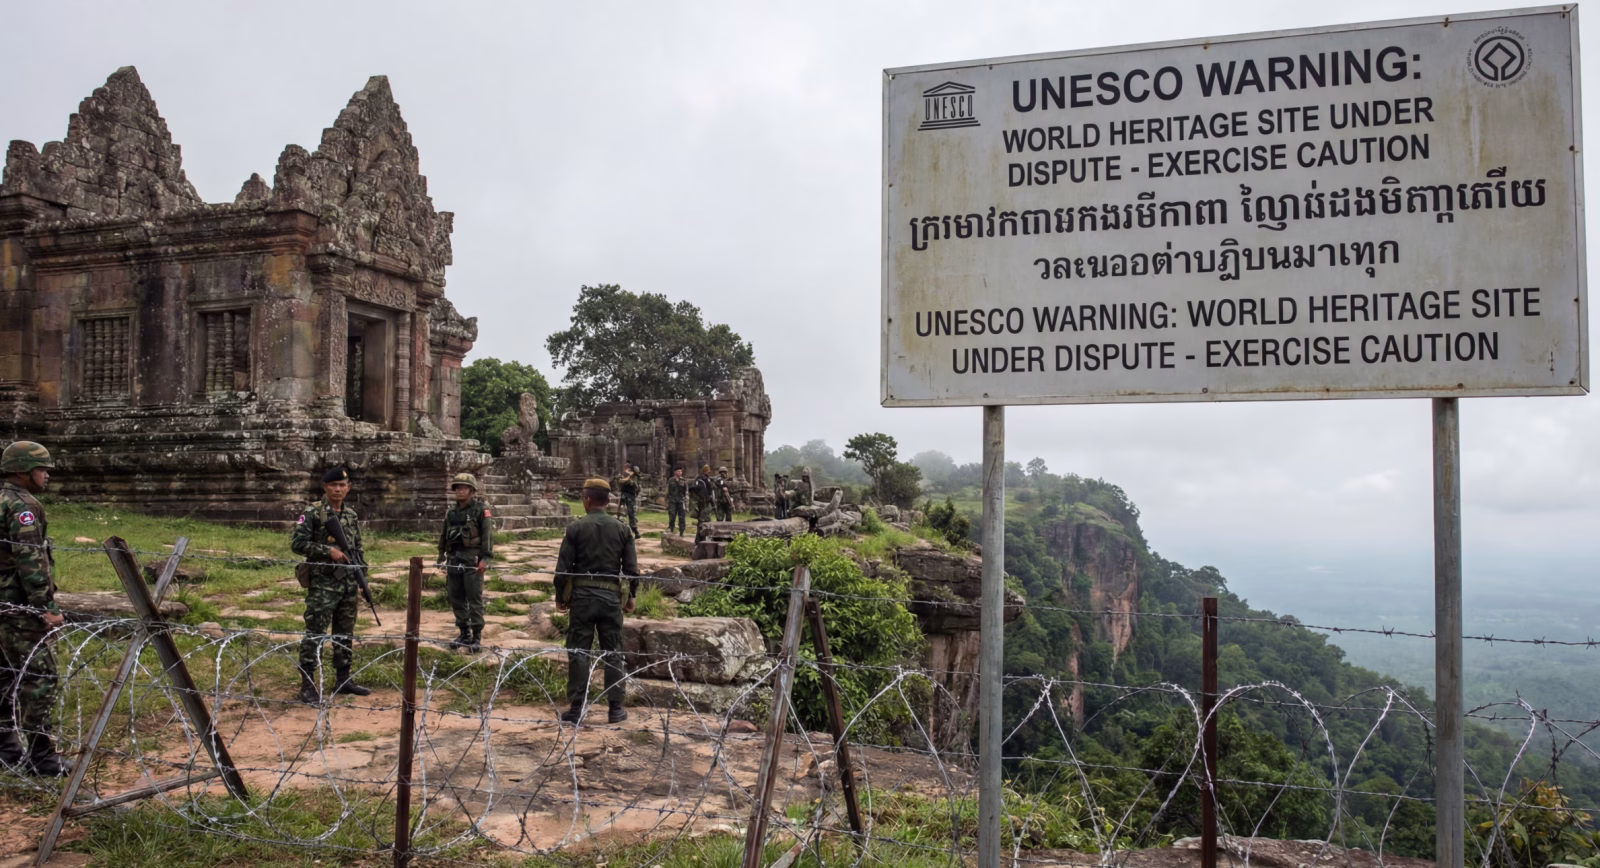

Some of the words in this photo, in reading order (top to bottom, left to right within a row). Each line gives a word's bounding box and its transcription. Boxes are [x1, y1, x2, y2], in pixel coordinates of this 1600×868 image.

[1012, 65, 1183, 113] UNESCO
[1196, 45, 1422, 98] WARNING:
[1003, 123, 1101, 154] WORLD
[1109, 110, 1249, 146] HERITAGE
[1257, 105, 1320, 136] SITE
[1329, 96, 1436, 130] UNDER
[1008, 155, 1122, 188] DISPUTE
[1148, 143, 1288, 179] EXERCISE
[1296, 133, 1430, 169] CAUTION
[915, 307, 1024, 338] UNESCO
[1032, 301, 1177, 333] WARNING:
[1186, 296, 1298, 328] WORLD
[1308, 289, 1461, 324] HERITAGE
[1471, 286, 1541, 319] SITE
[952, 345, 1046, 375] UNDER
[1055, 341, 1176, 372] DISPUTE
[1205, 335, 1351, 368] EXERCISE
[1360, 331, 1499, 365] CAUTION
